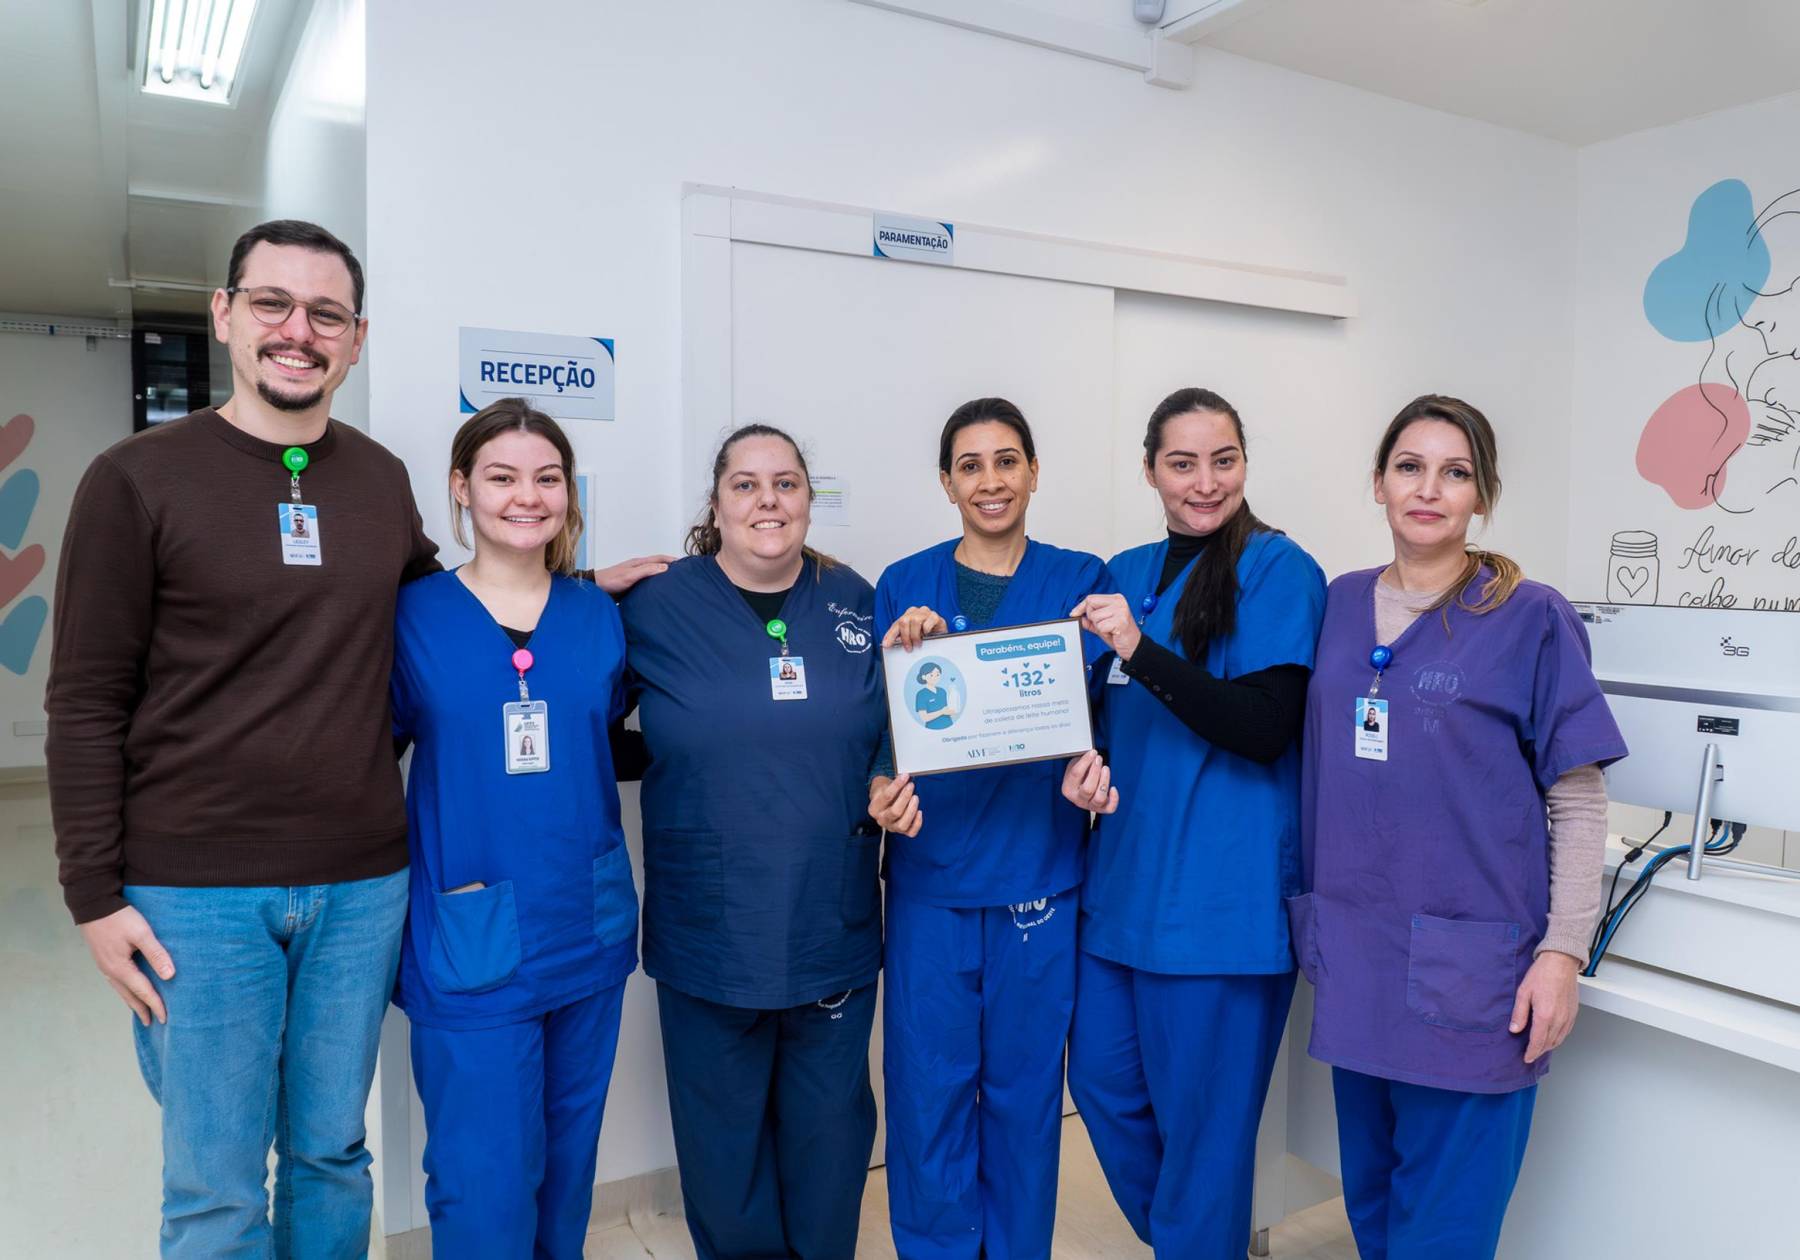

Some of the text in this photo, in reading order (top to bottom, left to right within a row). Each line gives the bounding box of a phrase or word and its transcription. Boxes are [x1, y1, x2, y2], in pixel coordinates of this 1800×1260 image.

[879, 230, 948, 250] PARAMENTAÇÃO
[480, 360, 595, 393] RECEPÇÃO
[1678, 525, 1760, 573] Amor
[1678, 576, 1738, 608] cabe
[840, 626, 866, 646] HRO
[980, 638, 1061, 656] Parabéns, equipe!
[1011, 670, 1044, 687] 132
[1019, 689, 1042, 697] litros
